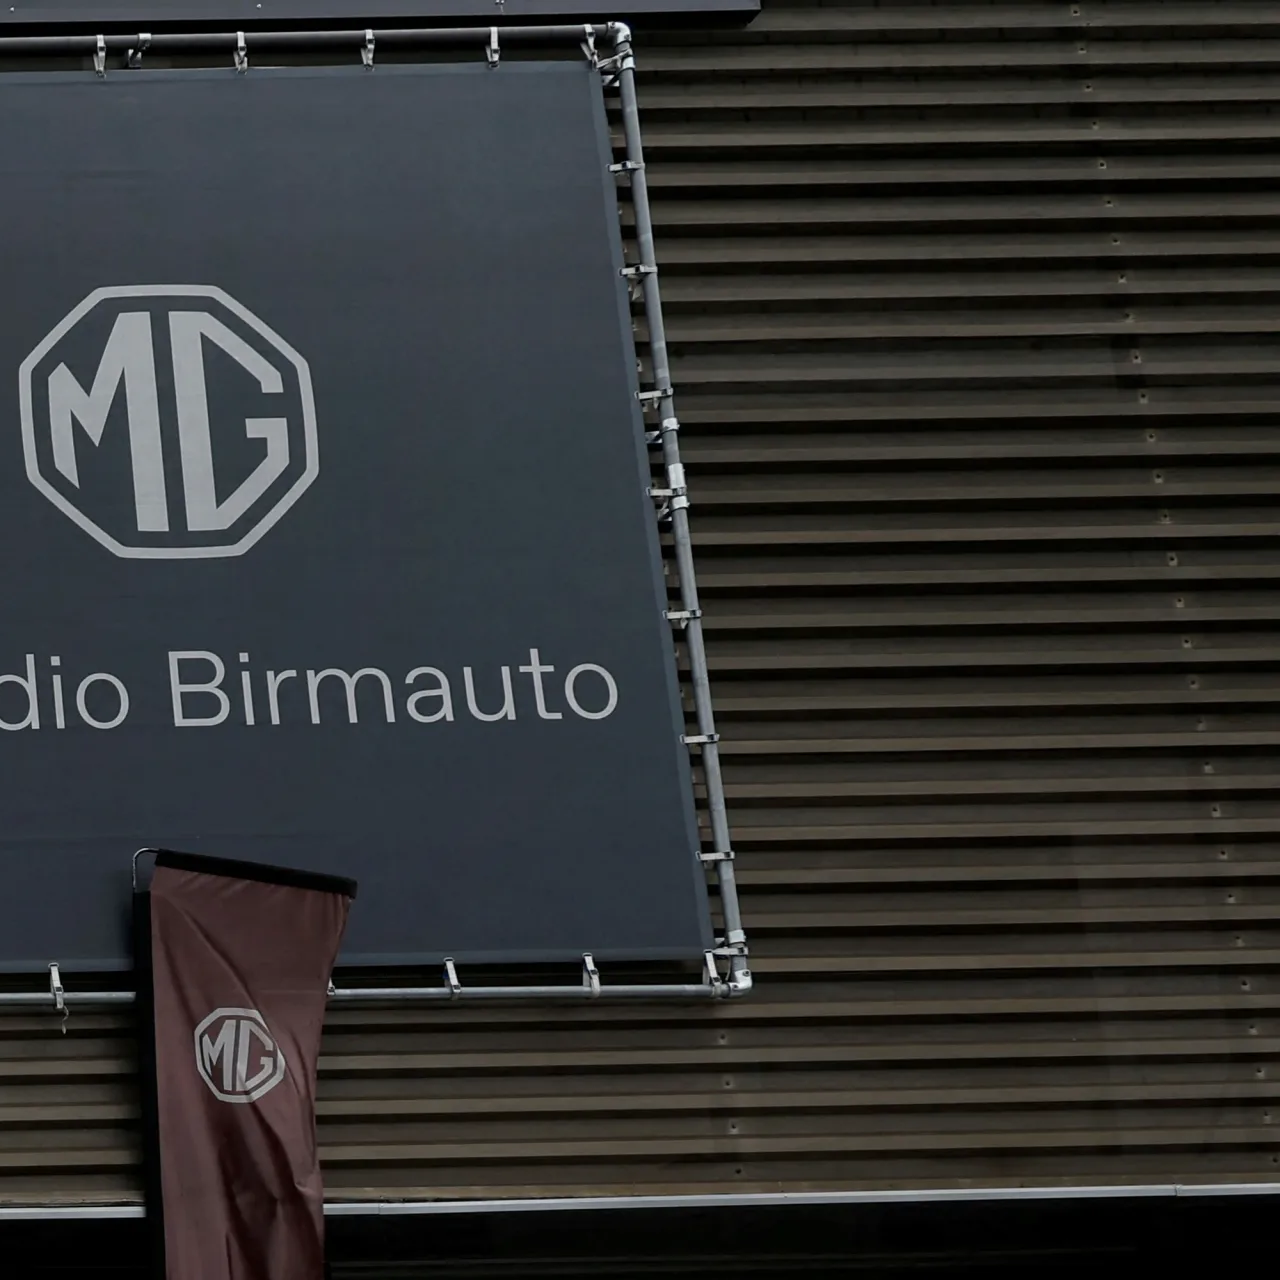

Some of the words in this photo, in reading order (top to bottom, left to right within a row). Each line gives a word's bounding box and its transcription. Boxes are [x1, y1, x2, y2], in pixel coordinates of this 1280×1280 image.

[48, 311, 289, 531] MG
[168, 648, 619, 728] Birmauto
[202, 1019, 274, 1092] MG
